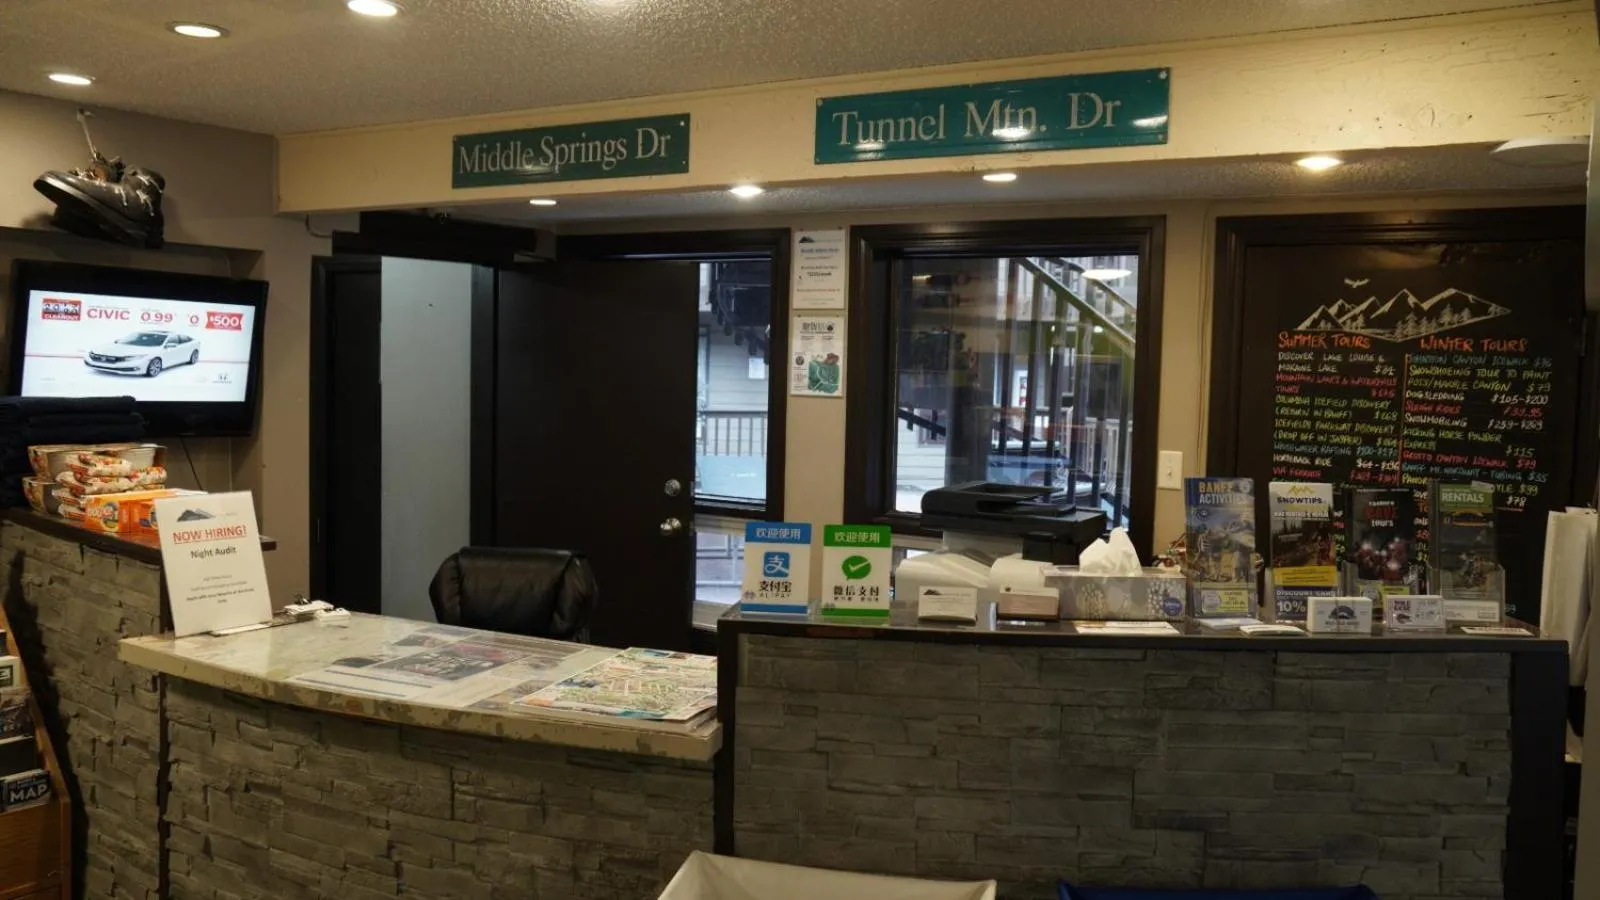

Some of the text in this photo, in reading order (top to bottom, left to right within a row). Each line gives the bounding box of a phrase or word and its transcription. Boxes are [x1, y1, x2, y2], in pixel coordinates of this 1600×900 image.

[832, 91, 1122, 146] Tunnel Mtn. Dr
[459, 127, 672, 175] Middle Springs Dr
[87, 307, 130, 321] CIVIC
[210, 314, 241, 328] $500
[1331, 333, 1372, 349] TOURS
[1420, 335, 1529, 352] WINTER TOURS
[1278, 351, 1315, 361] DISCOVER
[1322, 353, 1343, 362] LAKE
[1348, 353, 1375, 362] LOUISE
[1317, 364, 1338, 373] LAKE
[1409, 365, 1472, 377] SNOWSHOEING
[1476, 367, 1501, 378] TOUR
[1507, 368, 1518, 379] TO
[1472, 380, 1512, 392] CANYON
[1438, 429, 1465, 440] HORSE
[1199, 494, 1248, 505] ACTIVITIES
[1441, 491, 1485, 504] RENTALS
[172, 524, 247, 542] NOW HIRING!
[756, 527, 801, 540] 欢迎使用
[834, 531, 880, 543] 欢迎使用
[190, 545, 237, 559] Night Audit
[759, 581, 792, 593] 支付宝
[833, 585, 880, 597] 微信支付
[1276, 600, 1306, 613] 10%
[9, 783, 48, 803] MAP
